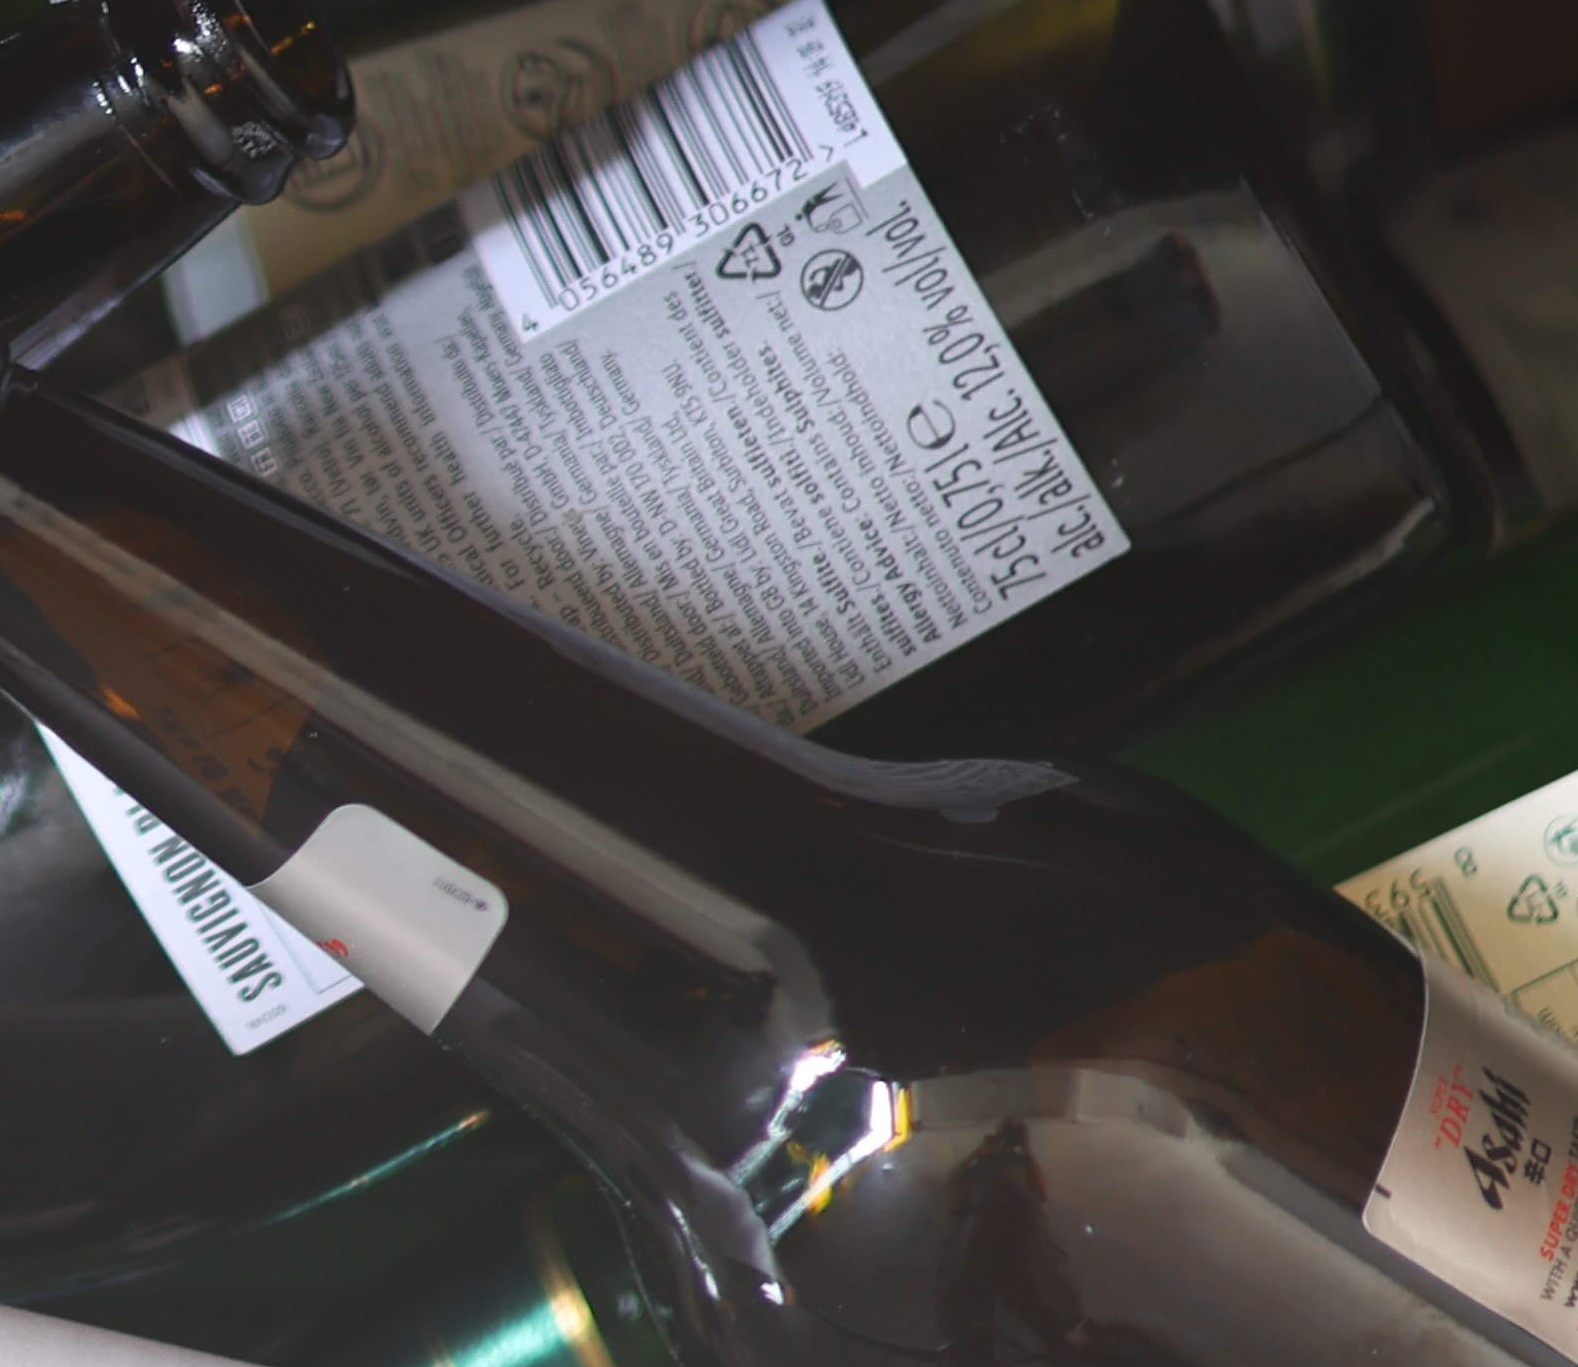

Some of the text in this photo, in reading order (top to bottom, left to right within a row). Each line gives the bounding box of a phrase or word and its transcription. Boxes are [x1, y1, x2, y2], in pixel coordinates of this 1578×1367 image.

[519, 154, 811, 336] 4 056489 306672
[865, 200, 954, 310] vol/vol.
[661, 359, 866, 689] Lidl House, 14 Kingston Road, Surbiton, KT5 9NU.
[661, 410, 843, 703] Imported into GB by: Lidl Great Britain Ltd,
[679, 323, 892, 674] Enthält Sulfite./Bevat sulfieten./Contient
[723, 342, 917, 657] sulfites./Contiene solfiti./Indeholder
[758, 345, 941, 643] Allergy Advice: Contains Sulphites.
[787, 333, 968, 629] Nettoinhalt:/Netto inhoud:/Volume
[827, 352, 993, 615] Contenuto netto:/Nettoindhold:
[984, 389, 1105, 558] alc./alk./Alc.
[152, 825, 281, 1001] SAUVIGNON
[1464, 1066, 1531, 1210] Asahi
[1523, 1138, 1552, 1185] 辛口
[1539, 1199, 1570, 1260] SUPER
[1559, 1162, 1578, 1199] DRY
[1540, 1258, 1567, 1300] WITH
[1559, 1245, 1573, 1260] A
